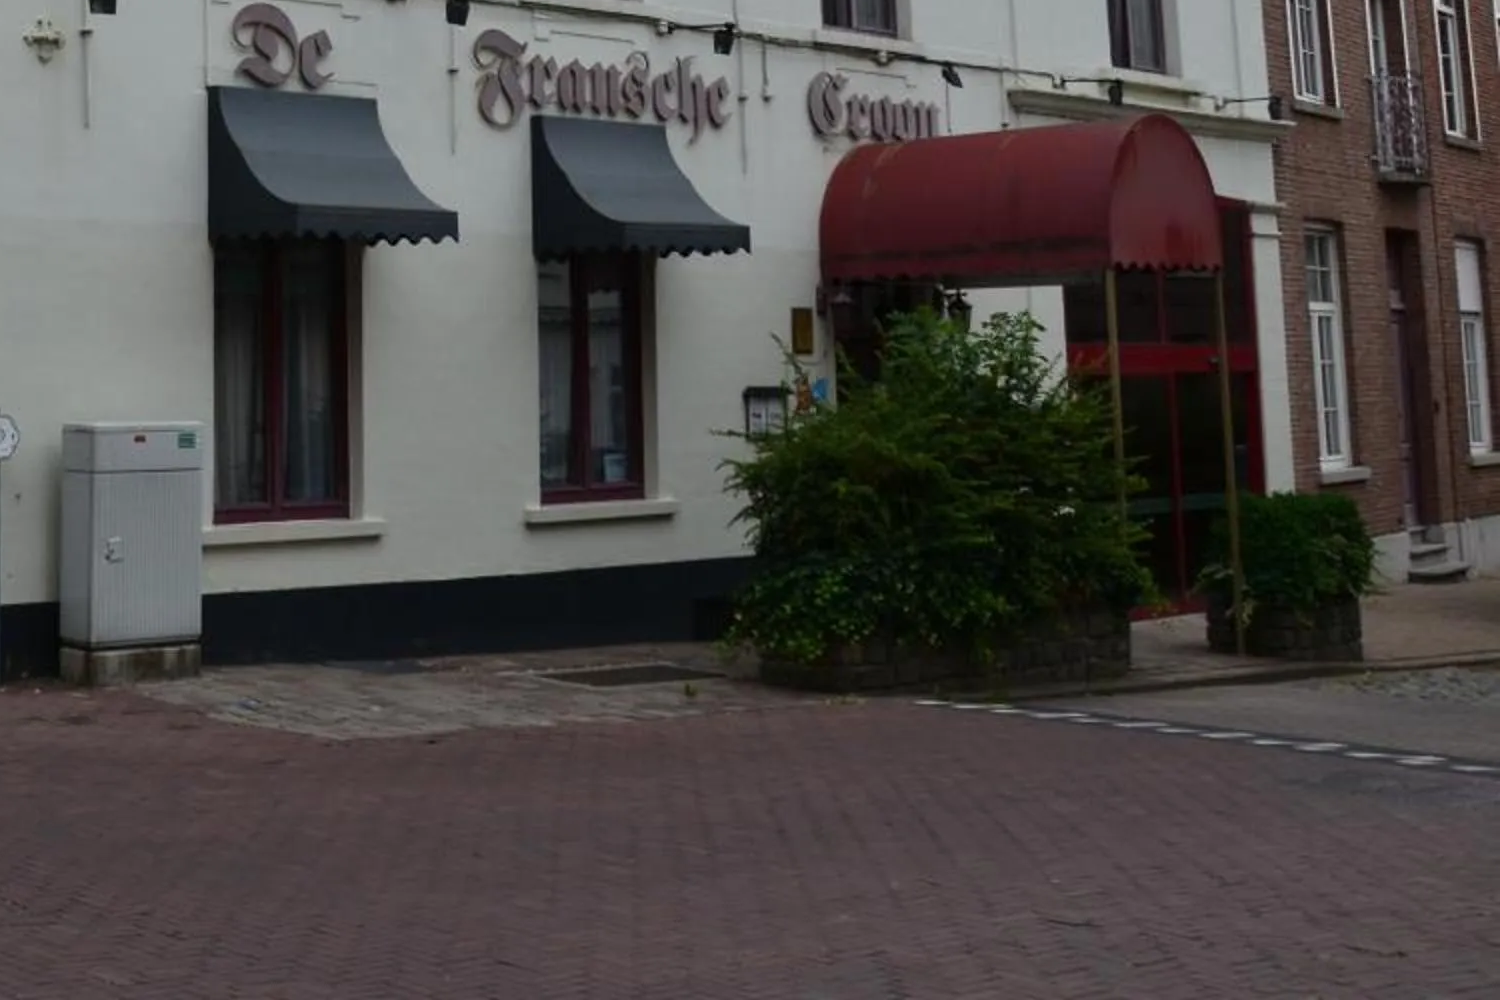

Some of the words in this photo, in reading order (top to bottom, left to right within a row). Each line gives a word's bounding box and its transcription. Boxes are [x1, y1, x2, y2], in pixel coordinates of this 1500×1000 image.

[231, 2, 335, 90] De
[473, 28, 731, 147] Fransche
[806, 70, 940, 142] Croon
